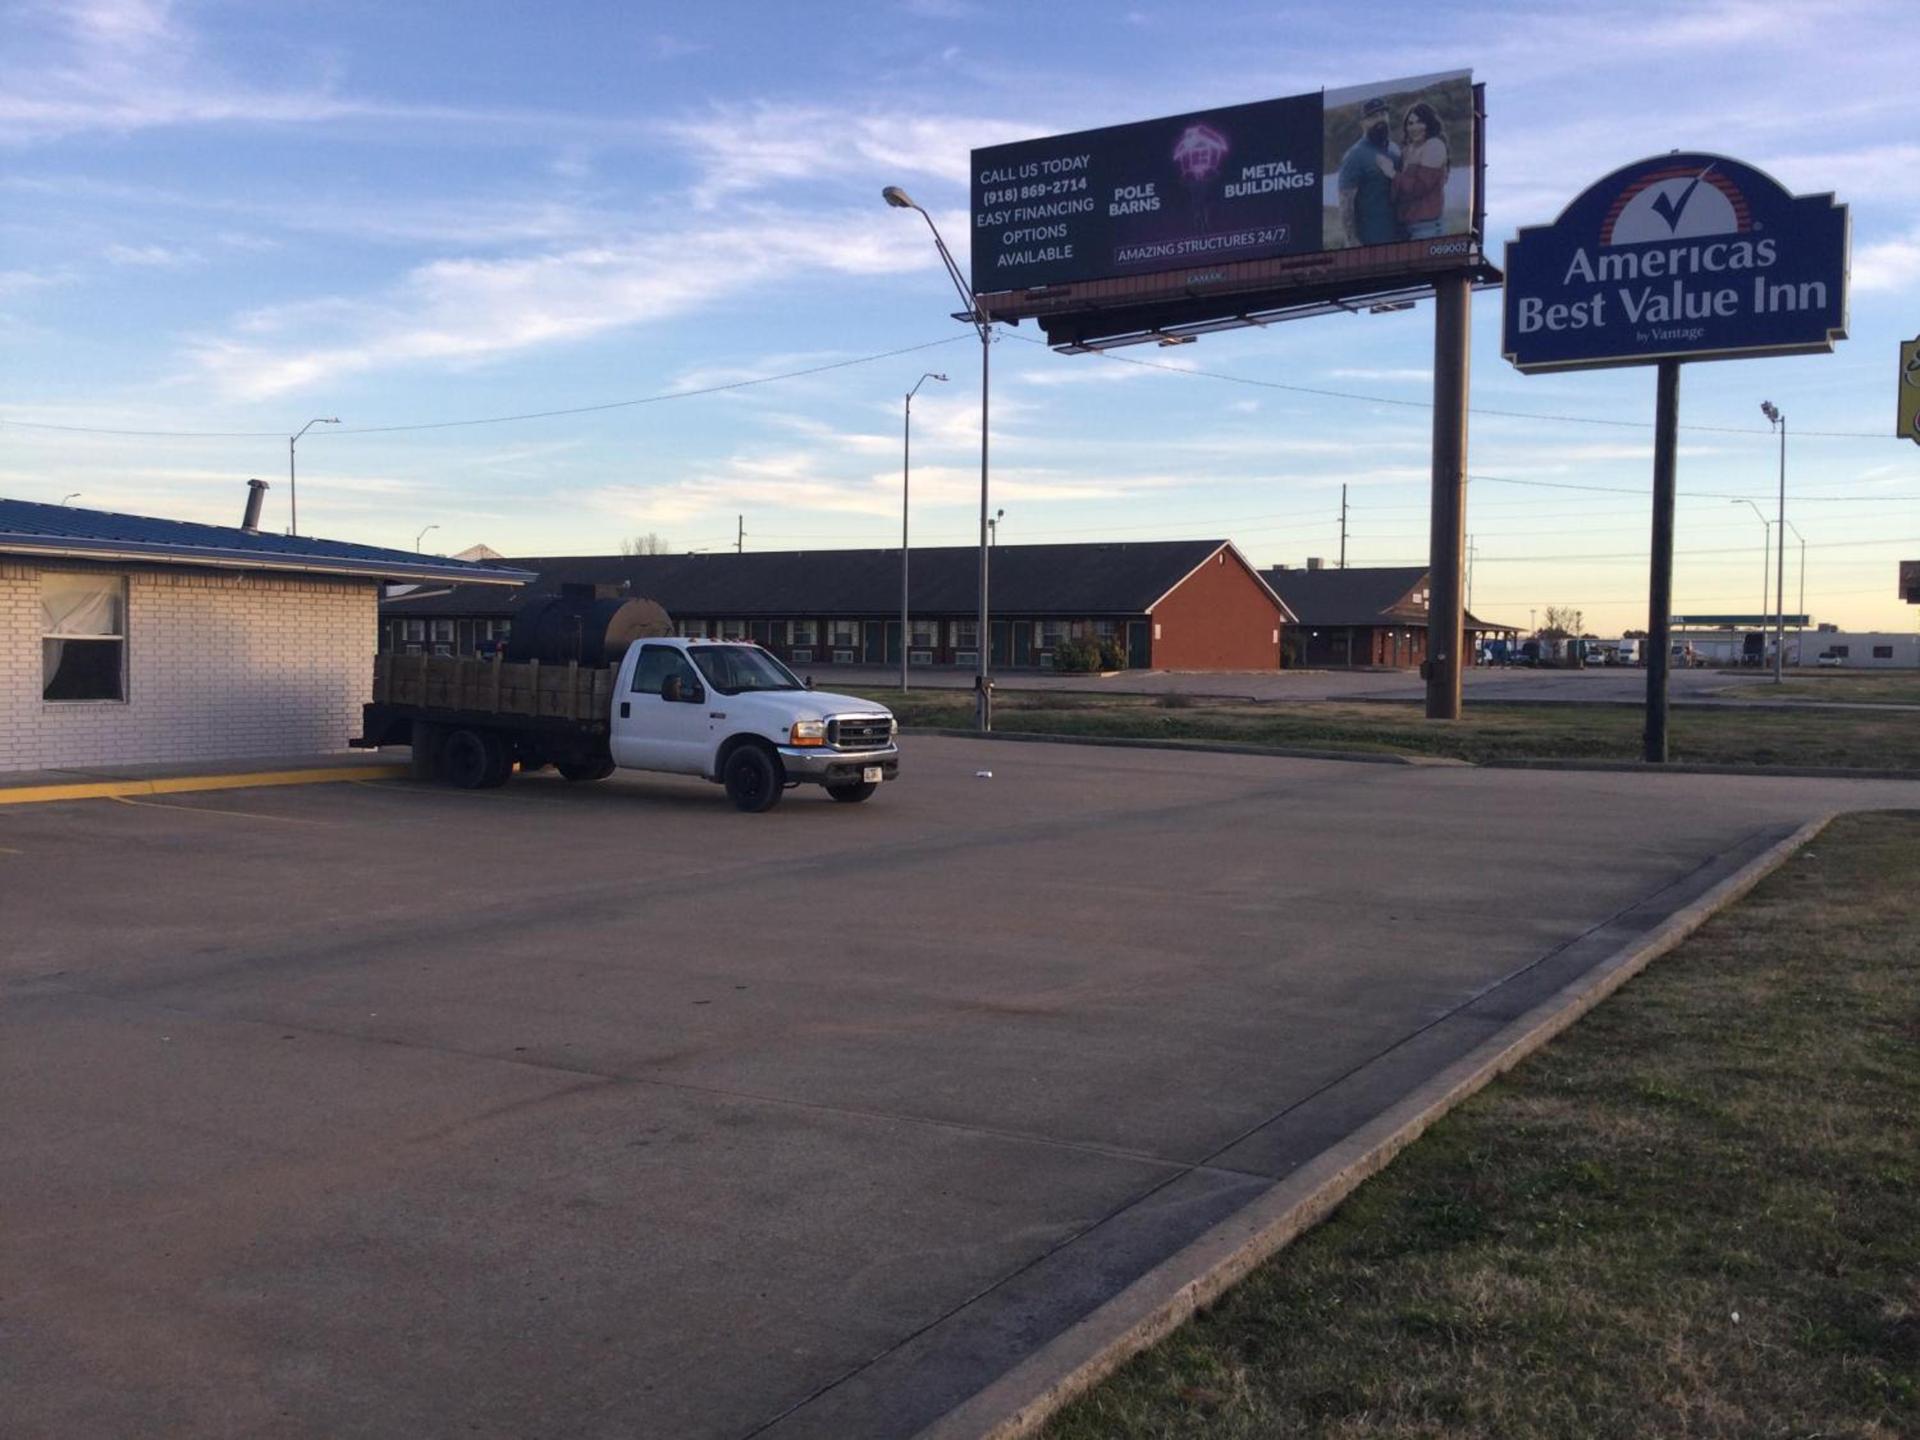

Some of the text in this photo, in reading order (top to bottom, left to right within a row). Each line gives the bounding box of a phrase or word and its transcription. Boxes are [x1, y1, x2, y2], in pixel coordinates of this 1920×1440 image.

[980, 154, 1091, 185] CALL US TODAY
[1242, 160, 1297, 180] METAL
[984, 177, 1087, 207] (918) 869-2714
[1114, 183, 1156, 201] POLE
[1225, 172, 1315, 198] BUILDINGS
[977, 197, 1095, 228] EASY FINANCING
[1109, 197, 1161, 217] BARNS
[1003, 223, 1068, 245] OPTIONS
[1118, 228, 1286, 262] AMAZING STRUCTURES 24/7
[997, 244, 1073, 267] AVAILABLE
[1563, 238, 1777, 285] Americas
[1518, 275, 1827, 333] Best Value Inn
[1636, 326, 1705, 343] by Vantage
